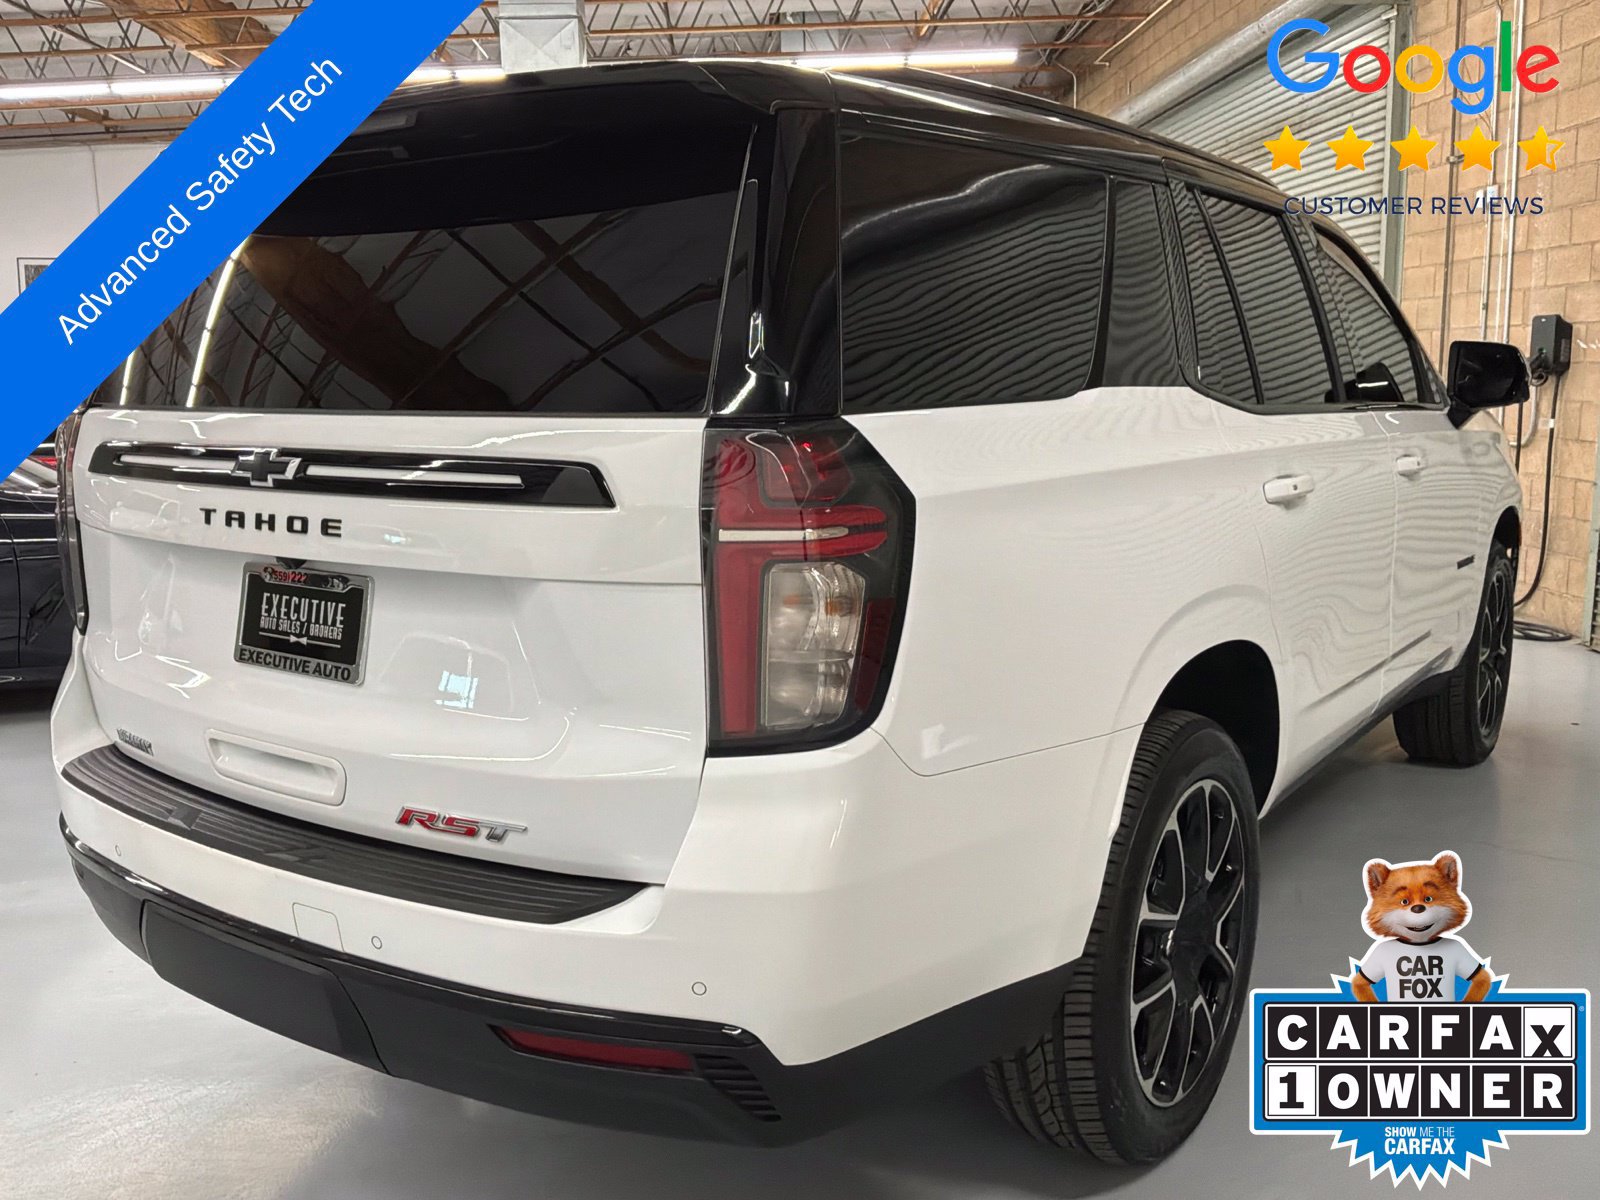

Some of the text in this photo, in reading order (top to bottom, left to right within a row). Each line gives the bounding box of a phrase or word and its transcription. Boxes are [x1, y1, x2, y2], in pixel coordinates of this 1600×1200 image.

[199, 508, 342, 538] TAHOE
[261, 592, 346, 629] EXECUTIVE
[260, 616, 277, 630] AUTO
[278, 620, 301, 634] SALES
[309, 624, 343, 641] BROKERS
[239, 648, 352, 681] EXECUTIVE AUTO
[395, 805, 528, 843] RST
